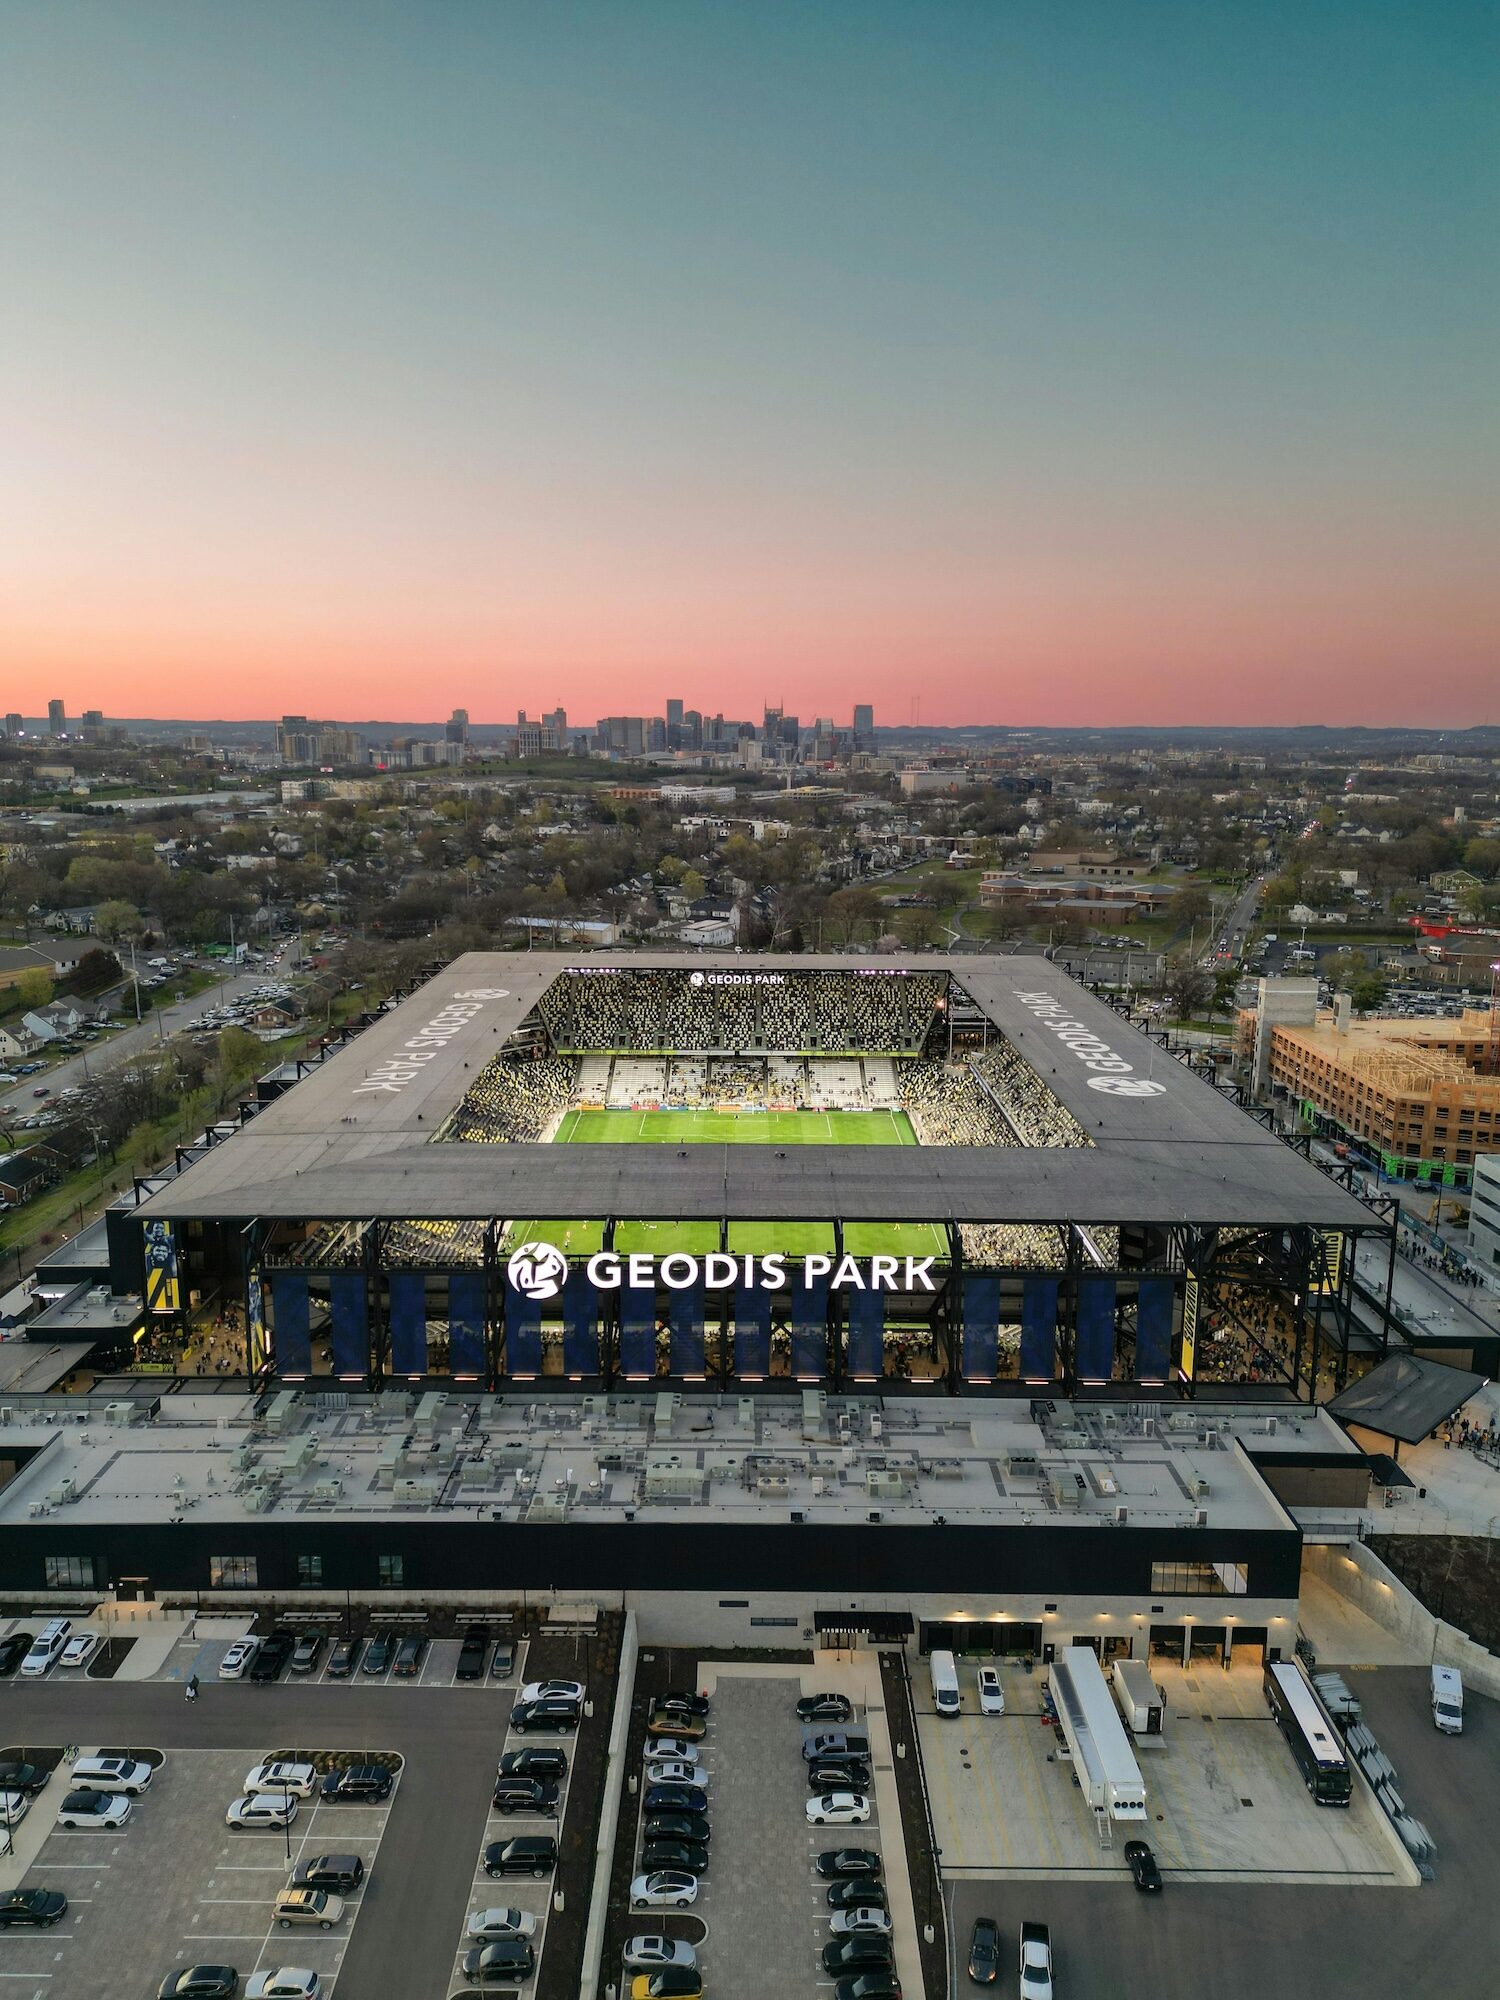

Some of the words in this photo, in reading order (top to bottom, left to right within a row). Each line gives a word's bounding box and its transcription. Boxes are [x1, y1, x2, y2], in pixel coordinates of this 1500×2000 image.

[707, 975, 752, 984] GEODIS
[755, 975, 785, 984] PARK
[1012, 990, 1074, 1018] PARK
[404, 1002, 483, 1048] GEODIS
[1044, 1020, 1134, 1072] GEODIS
[352, 1052, 437, 1093] PARK
[586, 1253, 786, 1289] GEODIS
[803, 1255, 936, 1291] PARK
